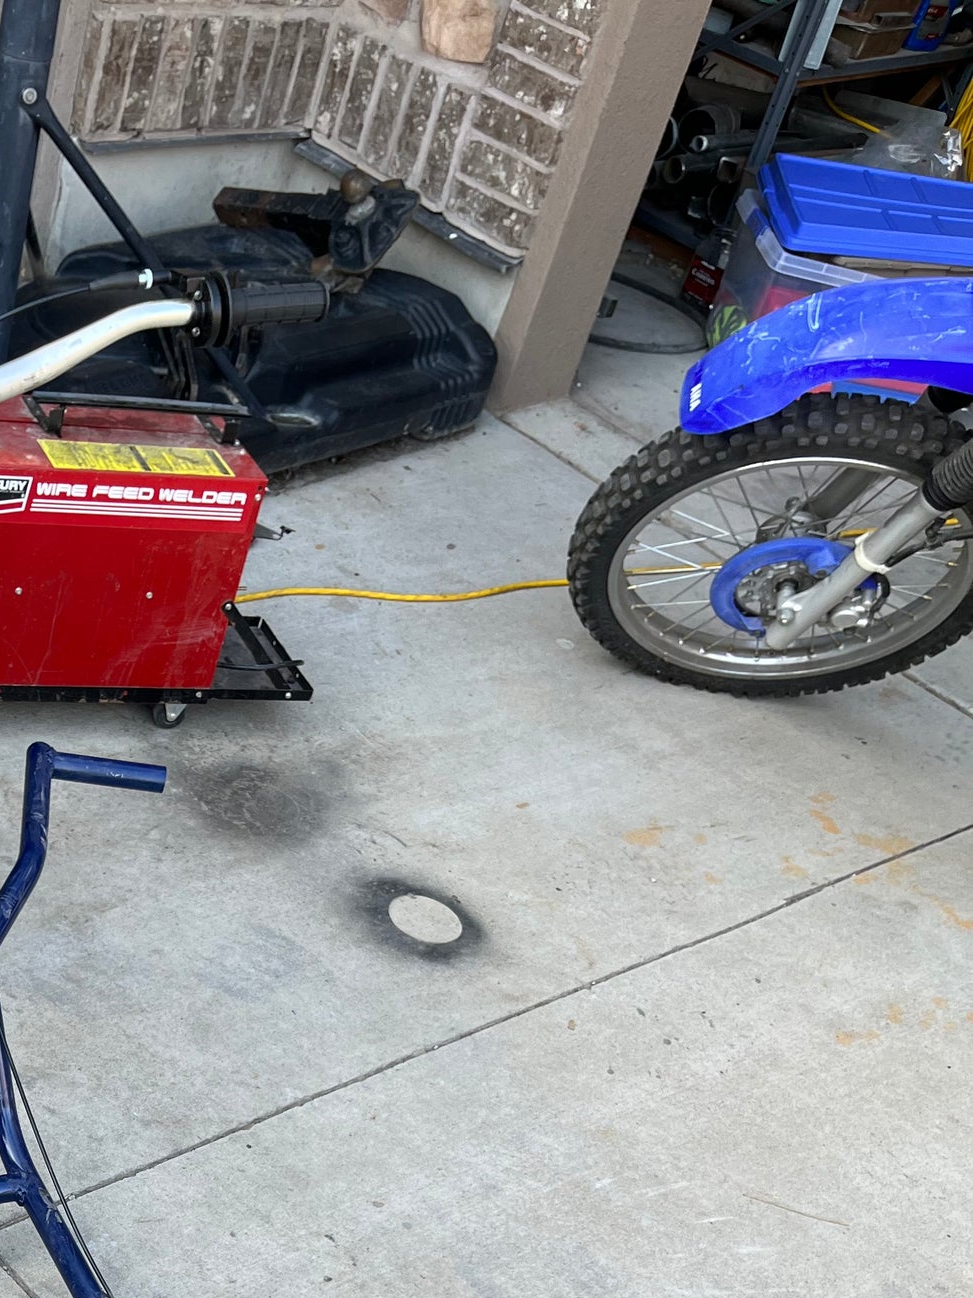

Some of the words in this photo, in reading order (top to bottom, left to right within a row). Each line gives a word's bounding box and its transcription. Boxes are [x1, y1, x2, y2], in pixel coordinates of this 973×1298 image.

[36, 482, 88, 498] WIRE
[92, 485, 155, 501] FEED
[158, 488, 247, 506] WELDER
